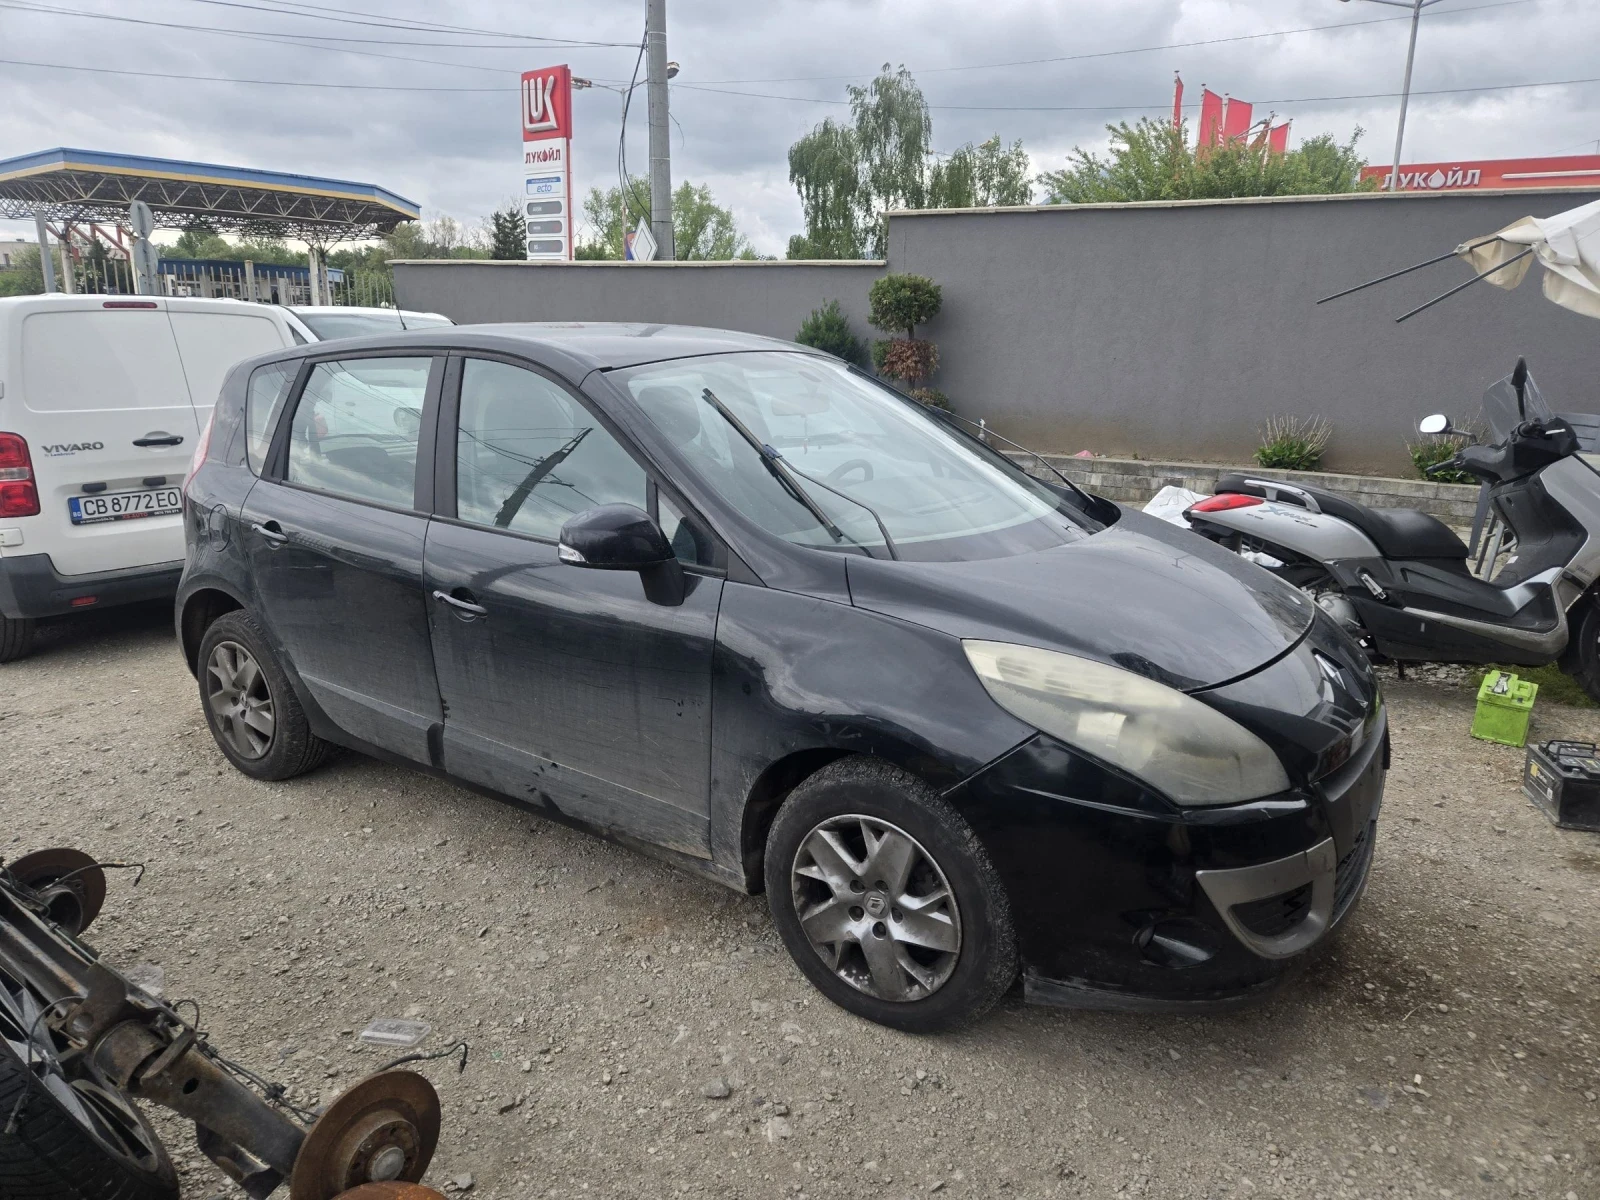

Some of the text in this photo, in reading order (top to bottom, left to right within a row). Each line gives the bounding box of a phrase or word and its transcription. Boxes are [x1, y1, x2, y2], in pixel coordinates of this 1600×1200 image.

[536, 183, 553, 193] ecto
[41, 441, 104, 453] VIVARO
[83, 500, 108, 516] CB
[111, 494, 155, 512] 8772
